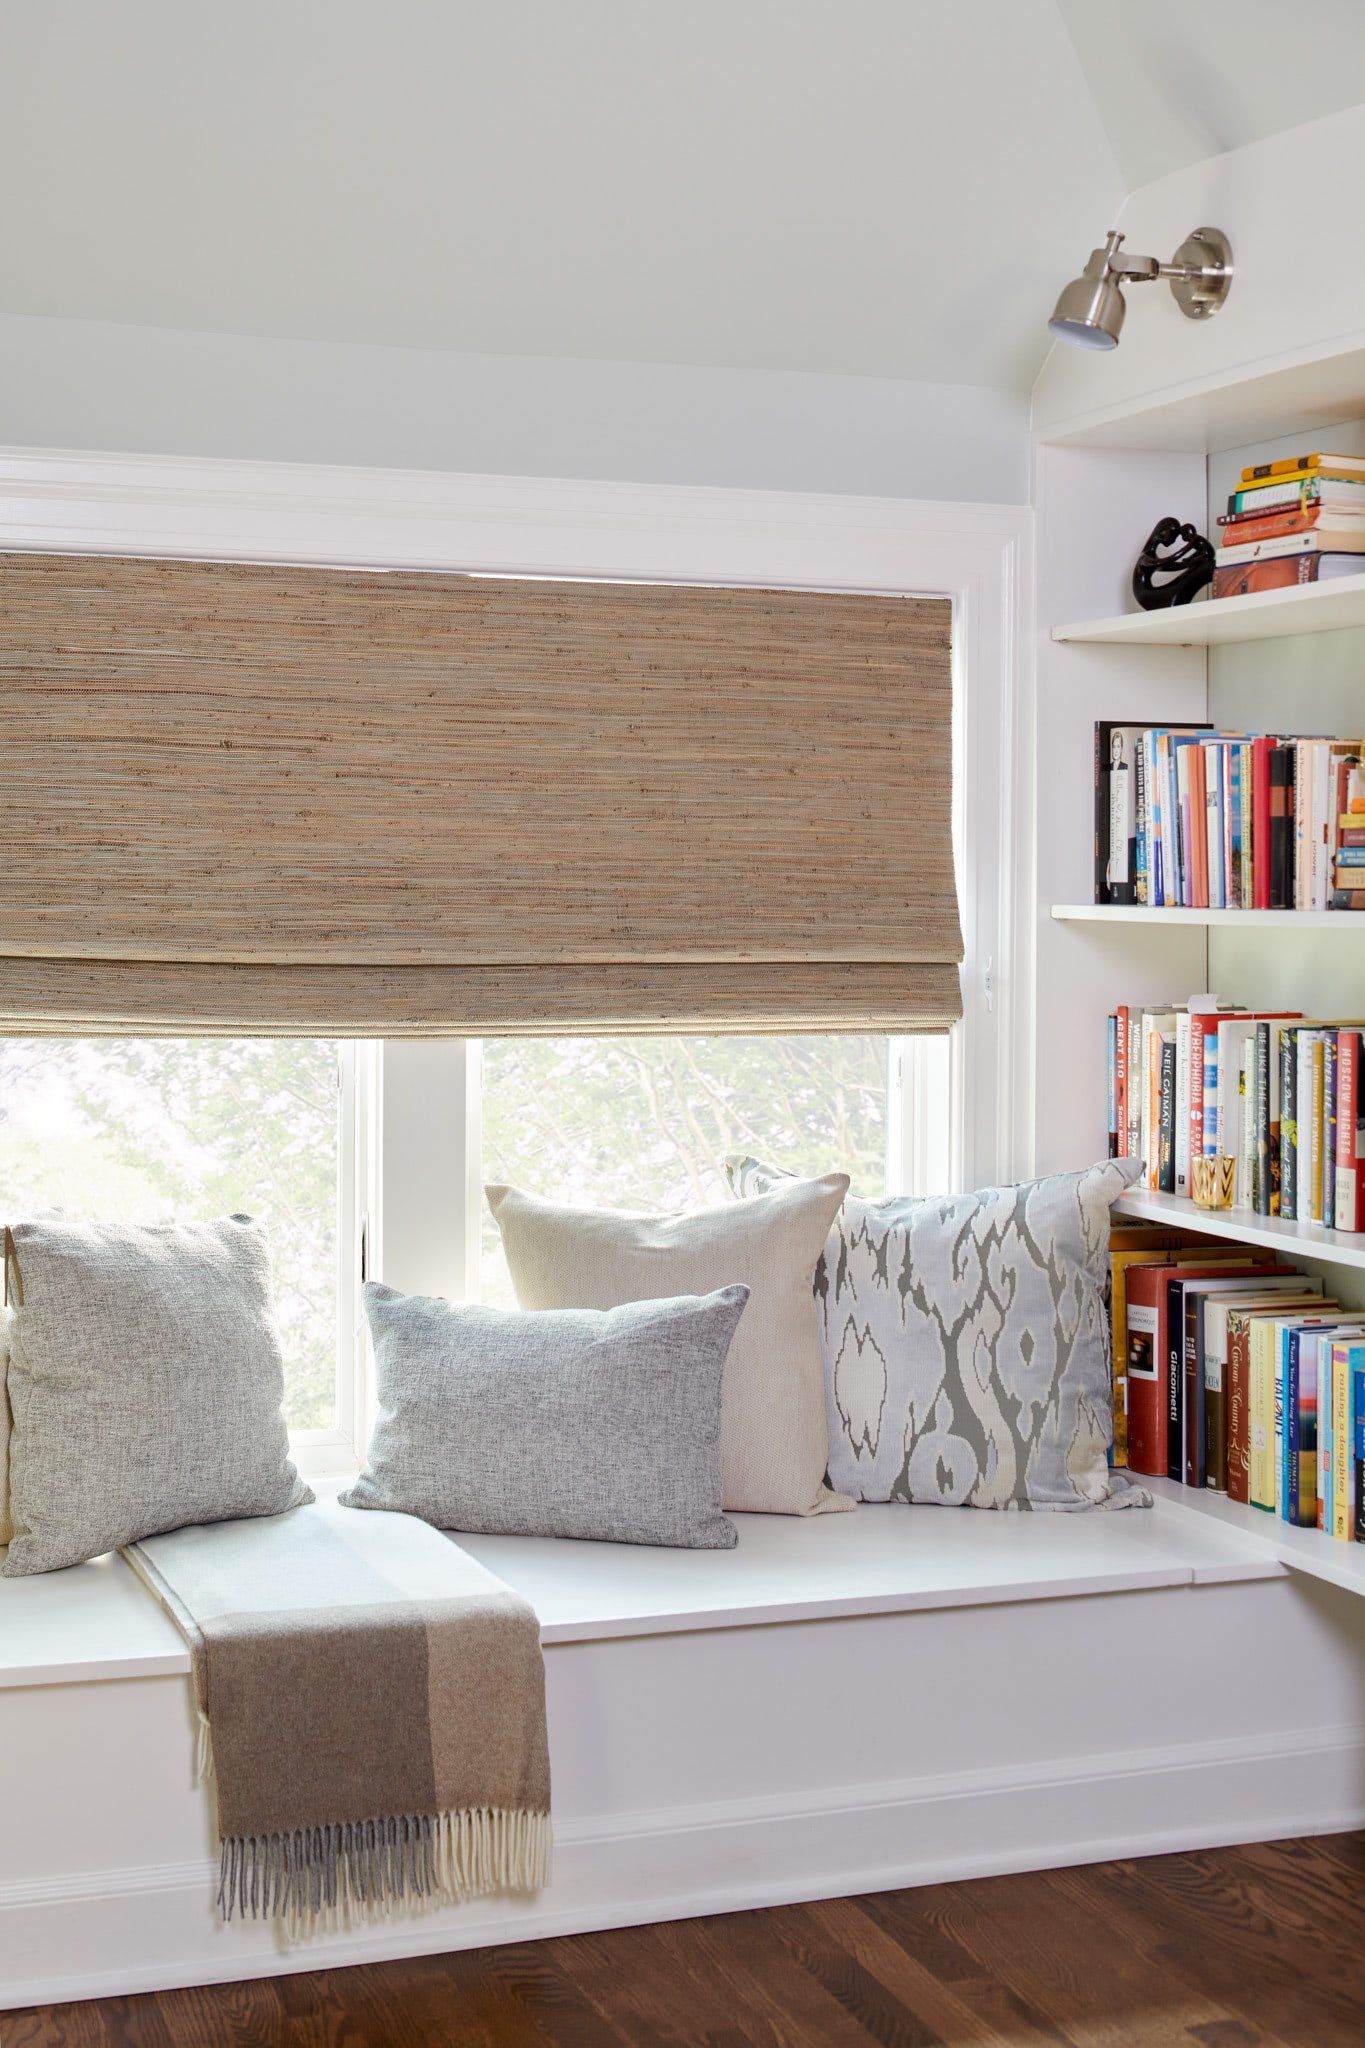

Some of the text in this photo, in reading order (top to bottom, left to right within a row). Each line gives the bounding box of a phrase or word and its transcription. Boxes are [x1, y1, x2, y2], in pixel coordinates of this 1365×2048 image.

[1133, 1023, 1141, 1064] William
[1259, 1032, 1266, 1045] BE
[1180, 1025, 1188, 1103] Henry Kissinger
[1324, 1038, 1332, 1109] HARPER LEE
[1163, 1049, 1171, 1127] NEIL GAIMAN
[1312, 1064, 1320, 1112] Introvert
[1340, 1047, 1352, 1155] MOSCOW NIGHTS
[1259, 1106, 1267, 1131] FOX
[1130, 1132, 1138, 1158] Days
[1170, 1350, 1178, 1421] Giacometti
[1231, 1345, 1243, 1383] Custom
[1230, 1394, 1243, 1436] Country
[1338, 1372, 1346, 1418] raising
[1338, 1435, 1346, 1494] daughter
